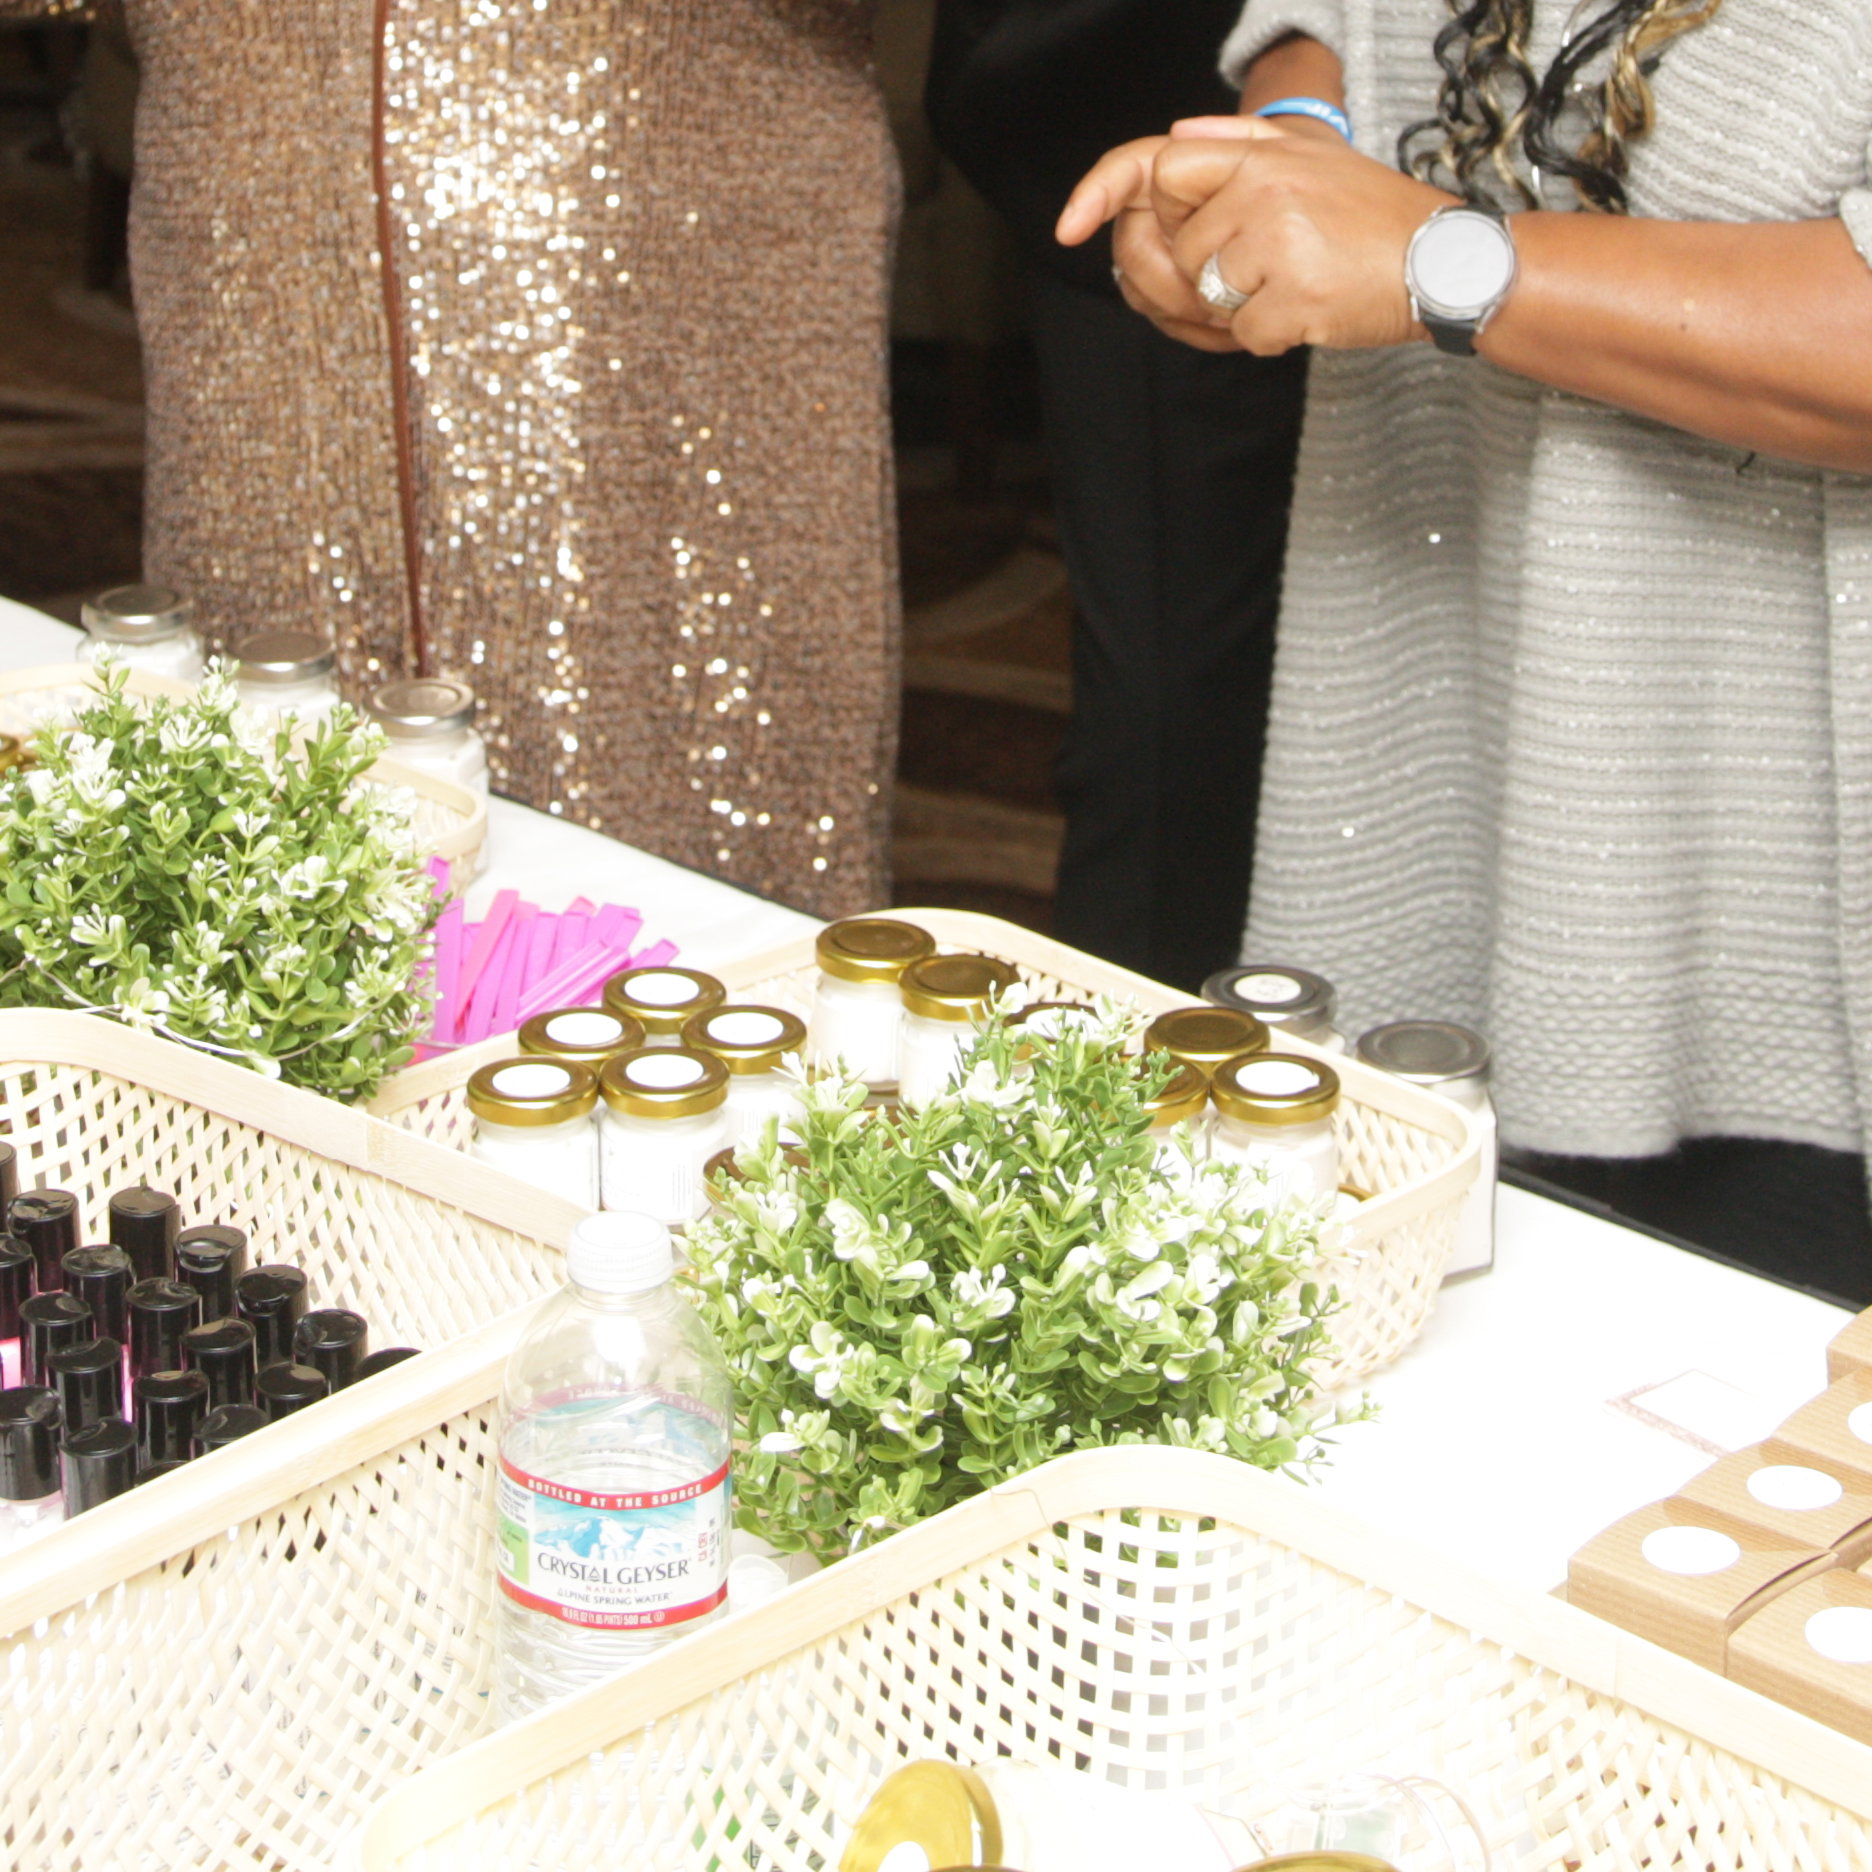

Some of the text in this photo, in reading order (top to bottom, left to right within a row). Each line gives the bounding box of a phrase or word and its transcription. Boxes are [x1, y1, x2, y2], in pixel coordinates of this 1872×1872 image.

[528, 1479, 582, 1504] BOTTLED
[591, 1496, 606, 1508] AT
[616, 1497, 642, 1508] THE
[651, 1483, 702, 1505] SOURCE
[537, 1552, 613, 1584] CRYSTAL
[616, 1559, 690, 1585] GEYSER
[557, 1588, 670, 1606] ALPINE SPRING WATER
[585, 1585, 638, 1594] NATURAL
[623, 1613, 639, 1625] 500
